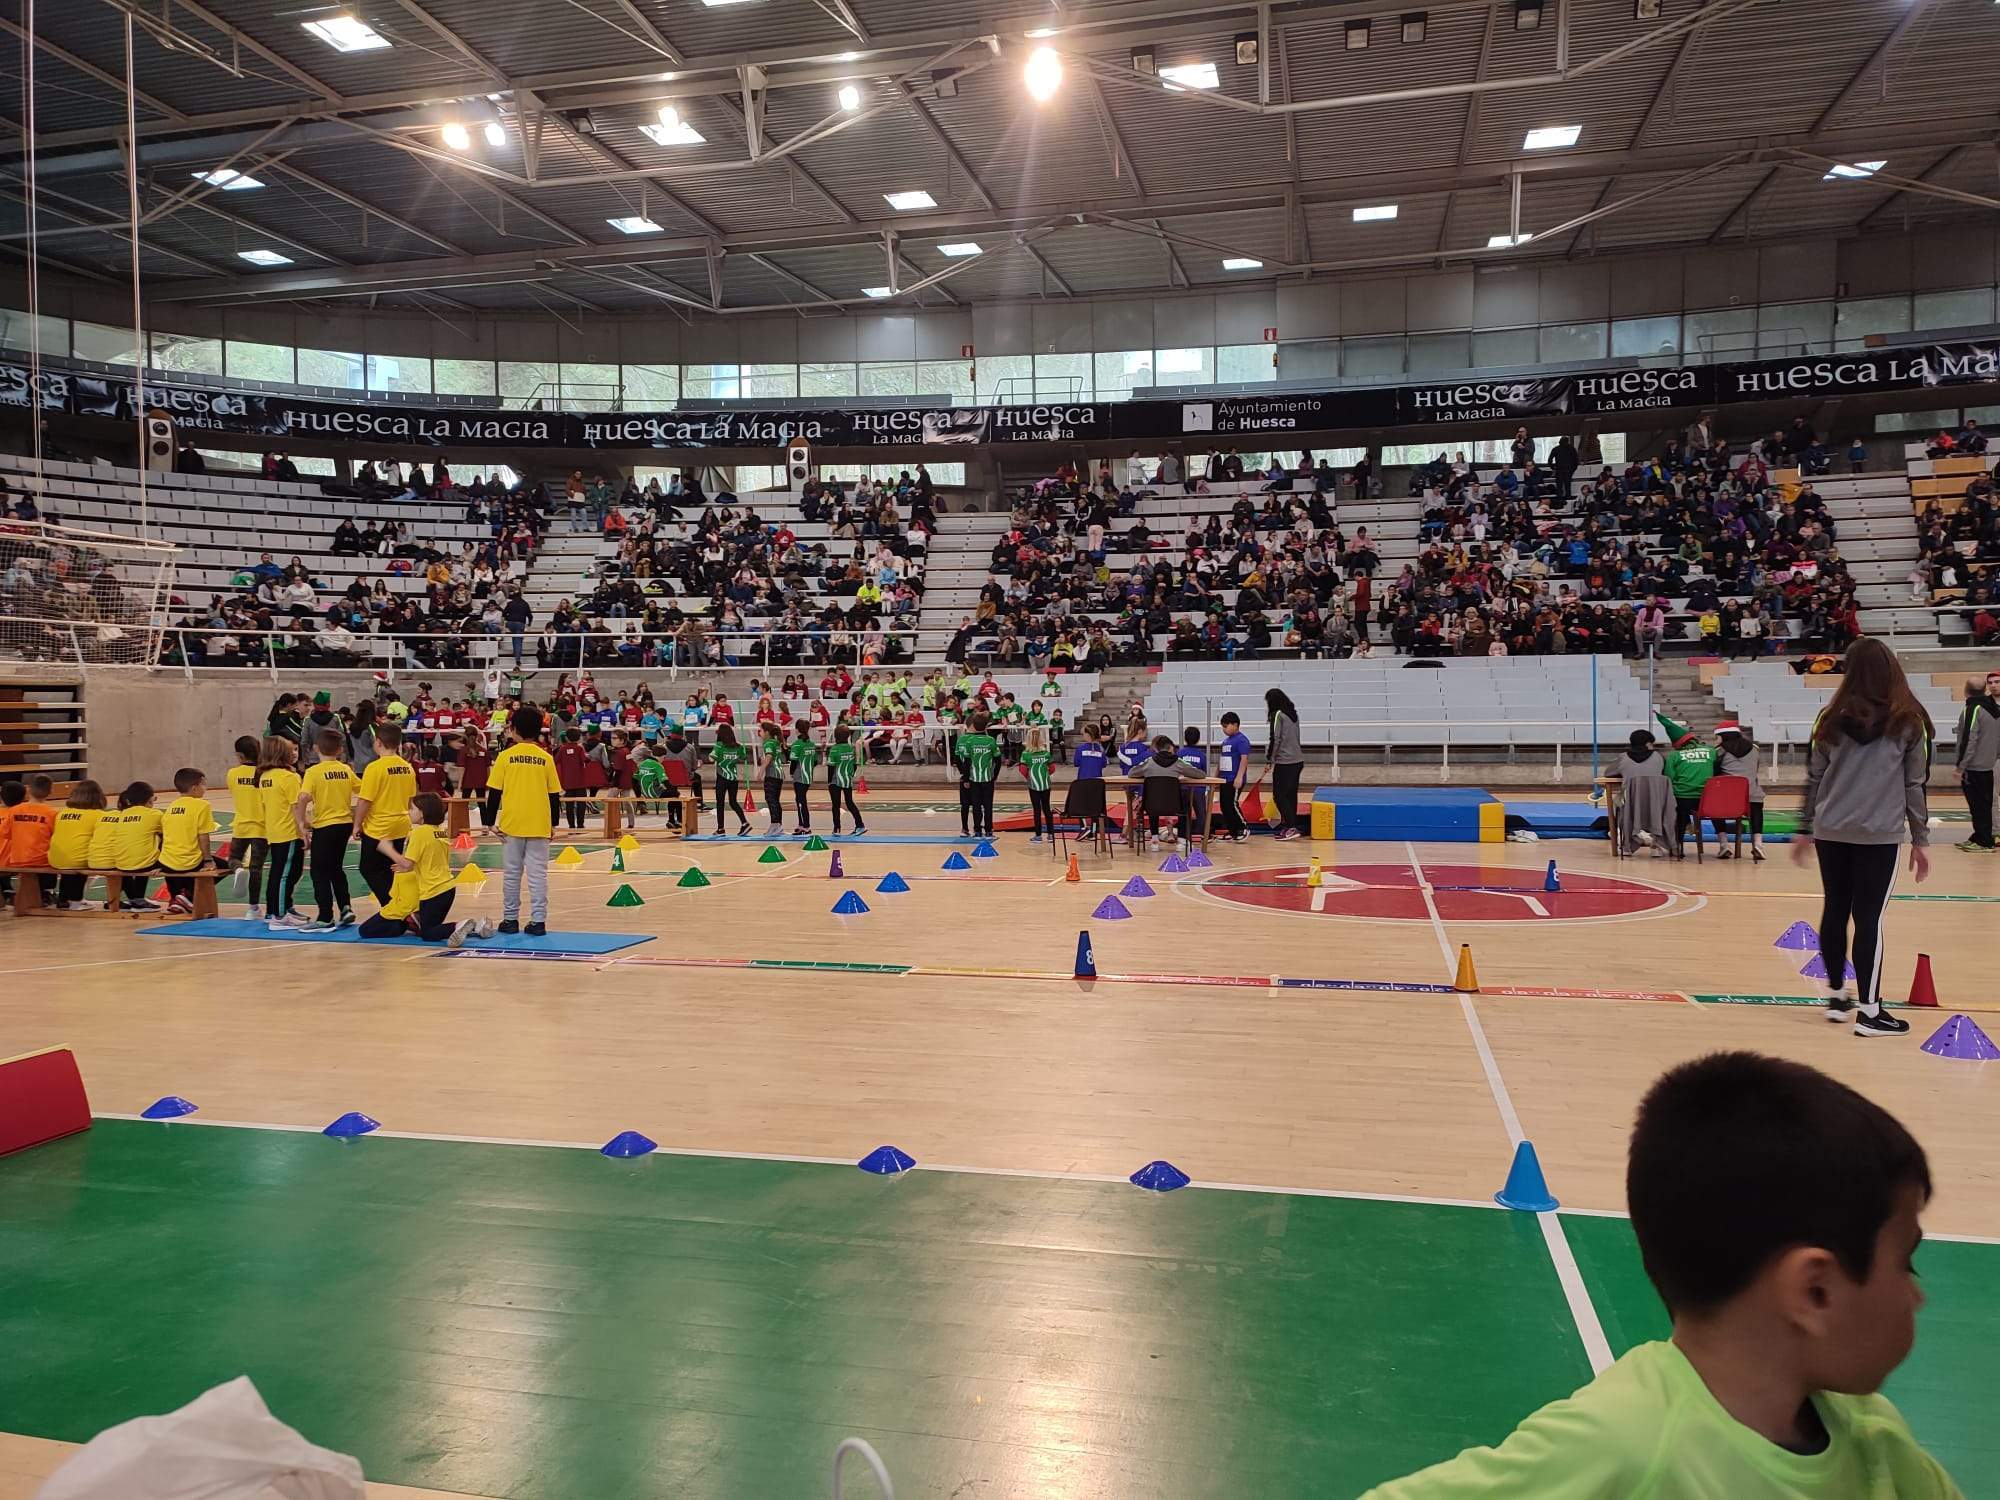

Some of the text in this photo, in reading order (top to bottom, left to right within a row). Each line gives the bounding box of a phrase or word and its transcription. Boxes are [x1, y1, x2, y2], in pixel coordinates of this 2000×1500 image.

[1218, 400, 1322, 418] Ayuntamiento
[1217, 417, 1297, 431] de Huesca
[509, 754, 547, 767] ANDERSON
[387, 767, 411, 775] MARCOS
[61, 813, 81, 821] IRENE
[1086, 949, 1094, 965] 8
